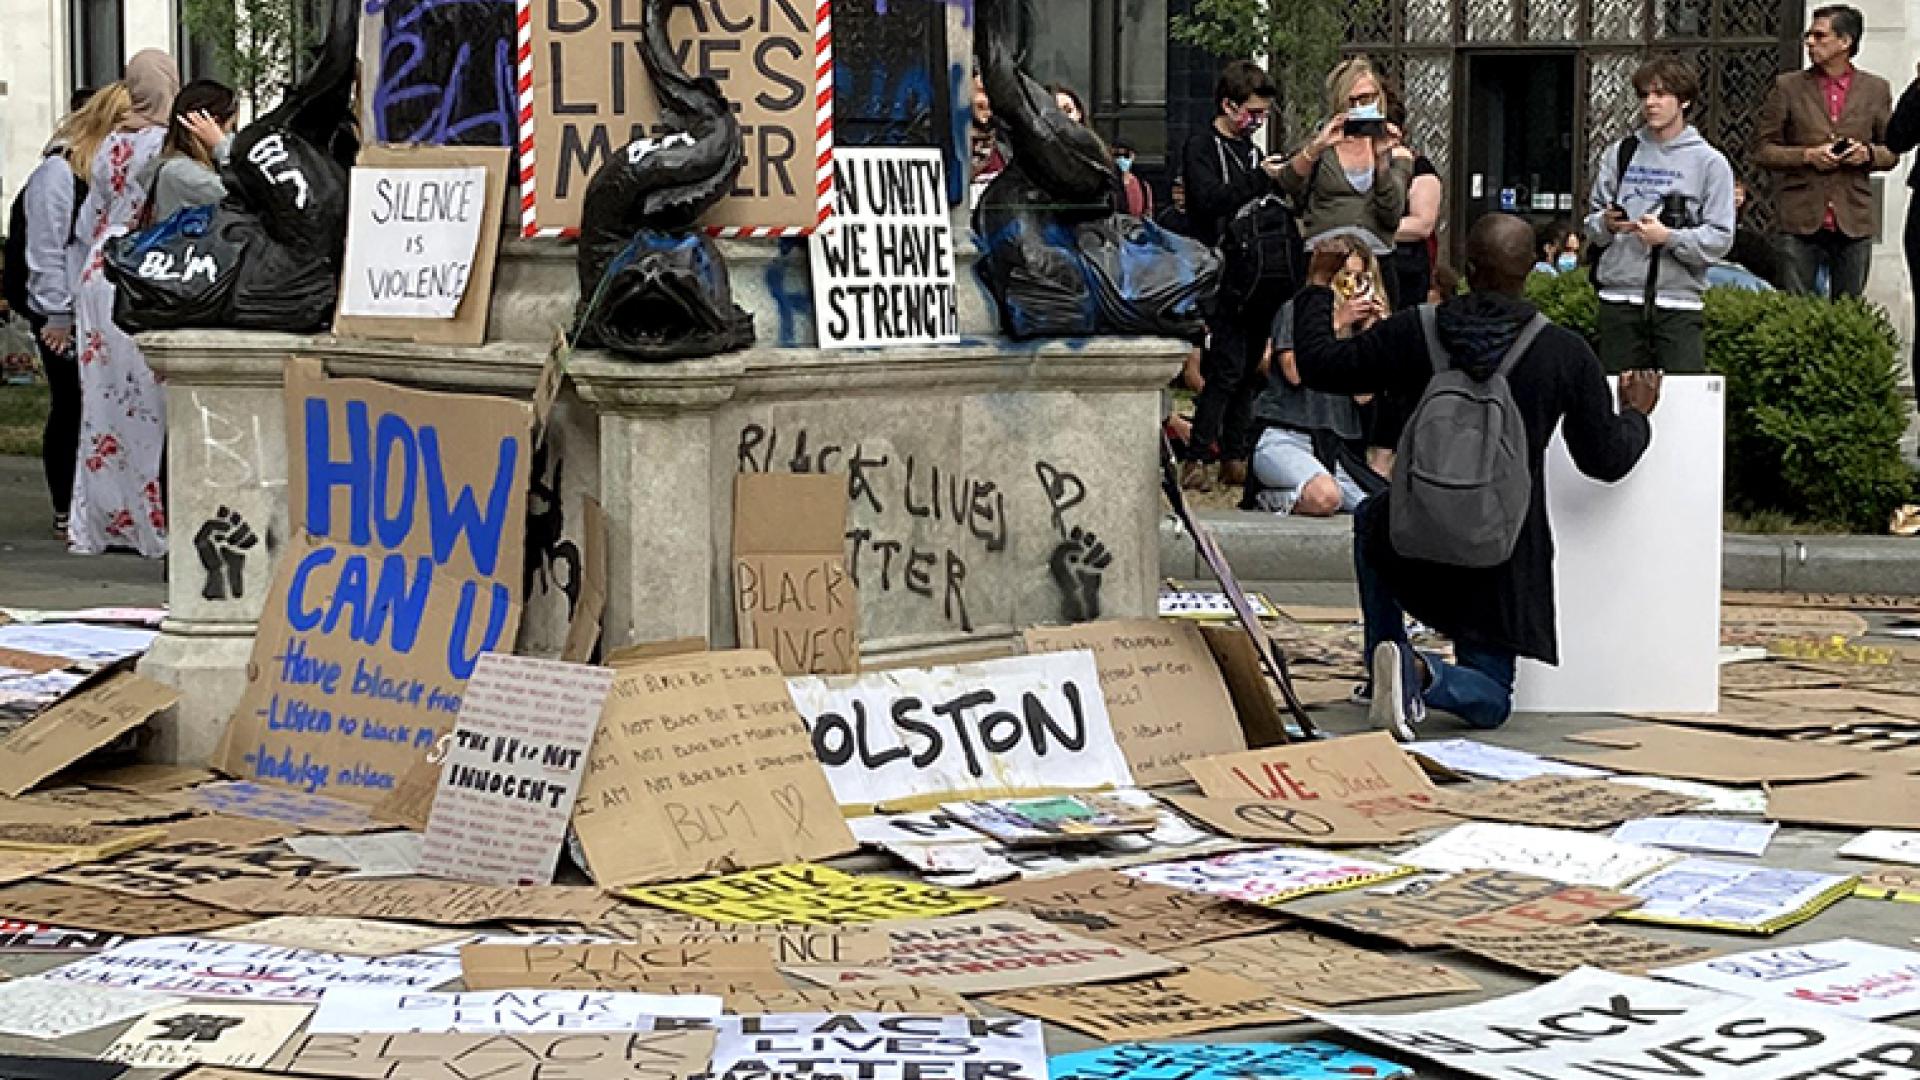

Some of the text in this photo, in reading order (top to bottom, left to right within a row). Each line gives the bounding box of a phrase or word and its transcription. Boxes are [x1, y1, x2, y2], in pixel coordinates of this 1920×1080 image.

[371, 178, 474, 225] SILENCE
[864, 158, 941, 216] UNITY
[405, 234, 425, 254] IS
[820, 225, 949, 279] WE HAVE
[367, 262, 468, 301] VIOLENCE
[827, 284, 958, 341] STRENGTH
[305, 397, 519, 577] HOW
[287, 546, 434, 654] CAN
[738, 560, 844, 615] BLACK
[845, 527, 974, 633] TTER
[351, 657, 425, 706] black
[447, 763, 567, 809] INNOCENT
[1231, 761, 1320, 801] WE
[664, 799, 759, 850] BLM
[294, 1033, 690, 1062] BLACK
[653, 1014, 1024, 1037] BLACK
[755, 1036, 981, 1055] LIVES
[1359, 994, 1687, 1056] BLACK
[727, 1056, 1023, 1080] ATTER
